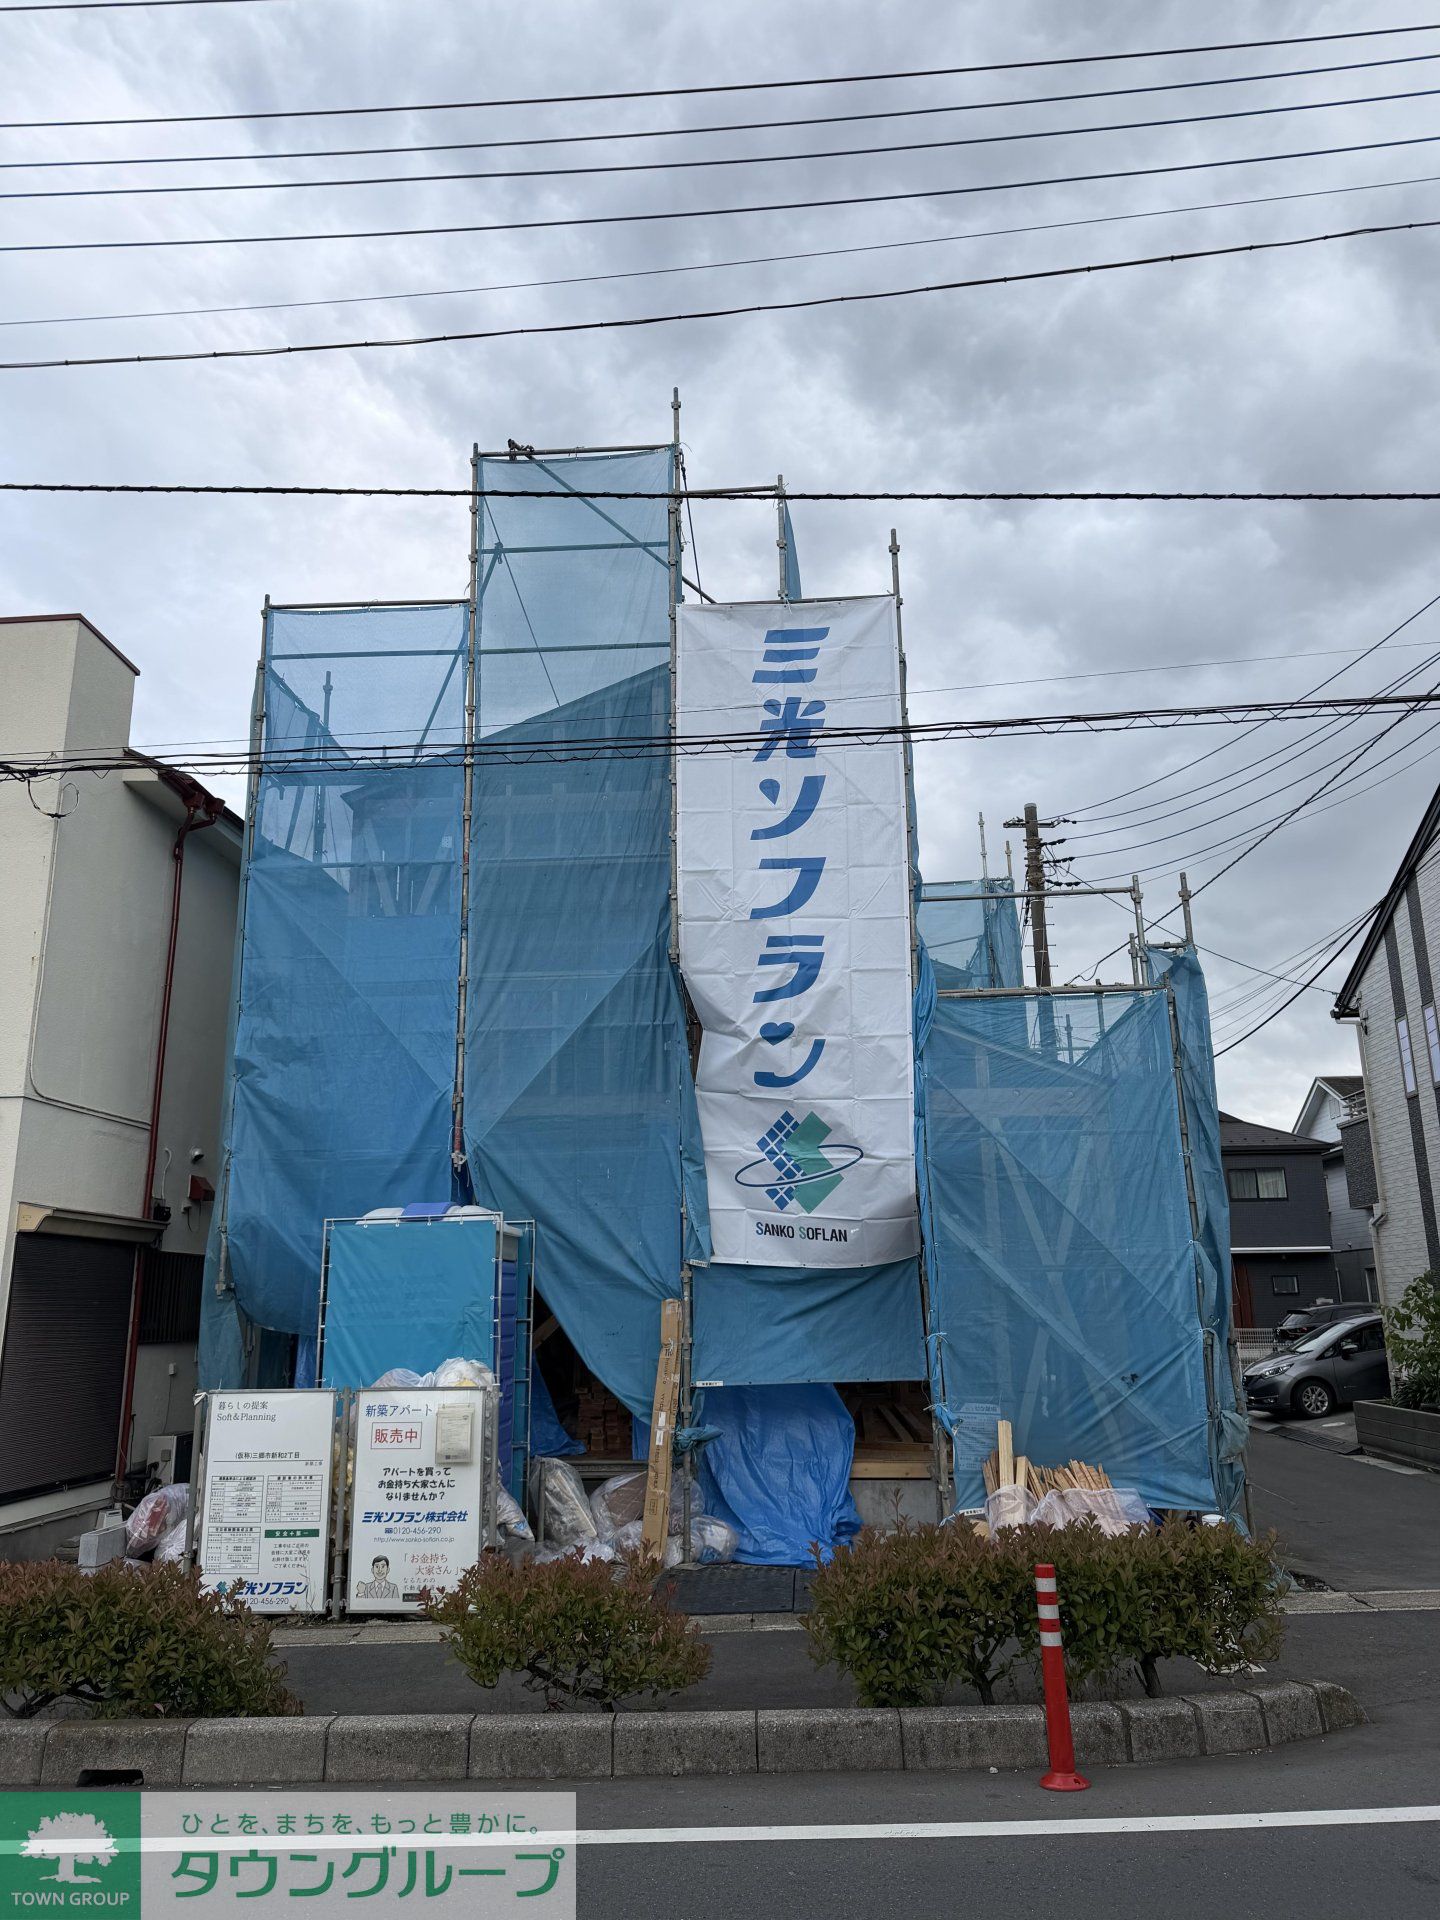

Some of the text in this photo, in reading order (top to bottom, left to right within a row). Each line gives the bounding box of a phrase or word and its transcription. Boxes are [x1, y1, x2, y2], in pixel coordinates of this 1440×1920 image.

[748, 626, 830, 1088] 三光ソフラン
[755, 1221, 848, 1243] SANKO SOFLAN
[218, 1401, 269, 1411] 暮らしの提案
[365, 1403, 433, 1418] 新築アパート
[374, 1428, 418, 1444] 販売中
[382, 1467, 452, 1477] アパートを買って
[377, 1479, 456, 1489] お金持ち大家さんに
[361, 1510, 469, 1523] 三光ソフラン株式会社
[393, 1526, 442, 1535] 0120-456-290
